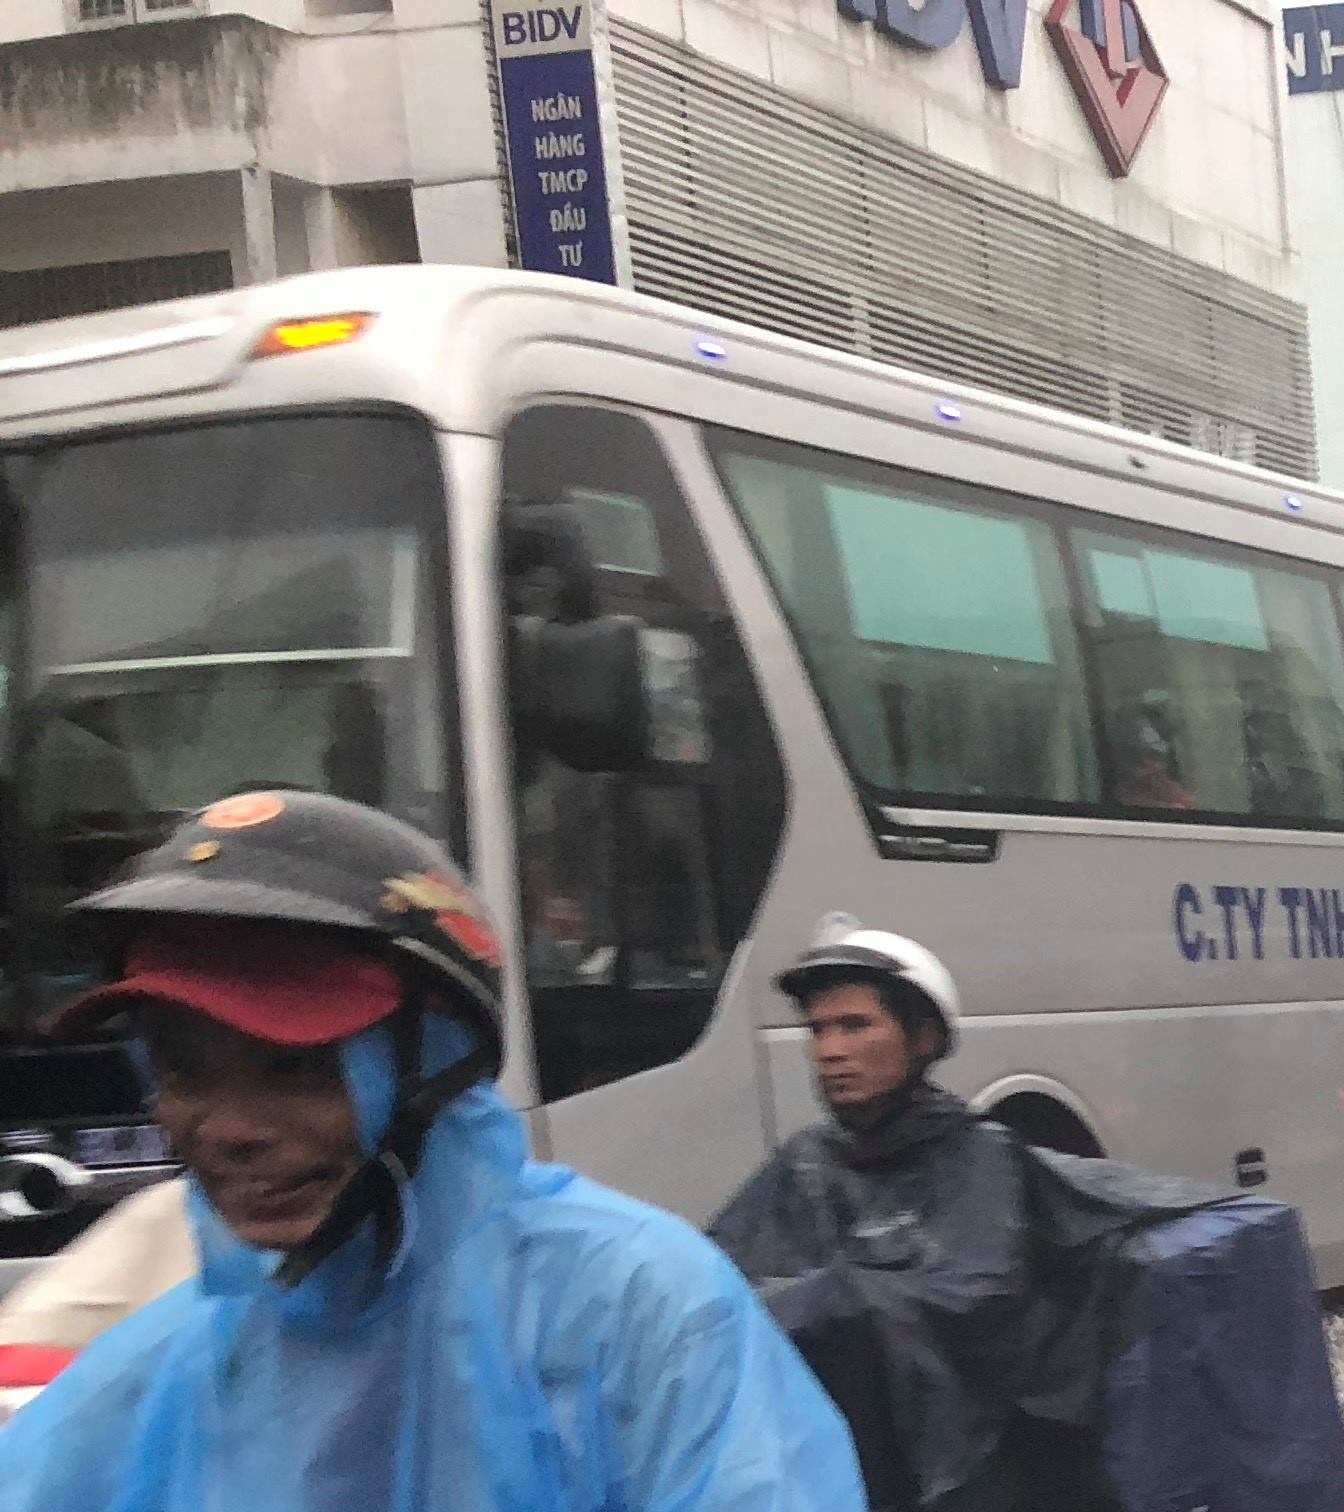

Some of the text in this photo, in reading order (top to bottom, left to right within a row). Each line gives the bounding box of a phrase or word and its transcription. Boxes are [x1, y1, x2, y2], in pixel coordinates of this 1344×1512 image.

[503, 5, 582, 45] BIDV
[531, 92, 582, 122] NGÂN
[535, 131, 586, 160] HÀNG
[538, 168, 588, 195] TMCP
[1174, 883, 1266, 962] C.TY
